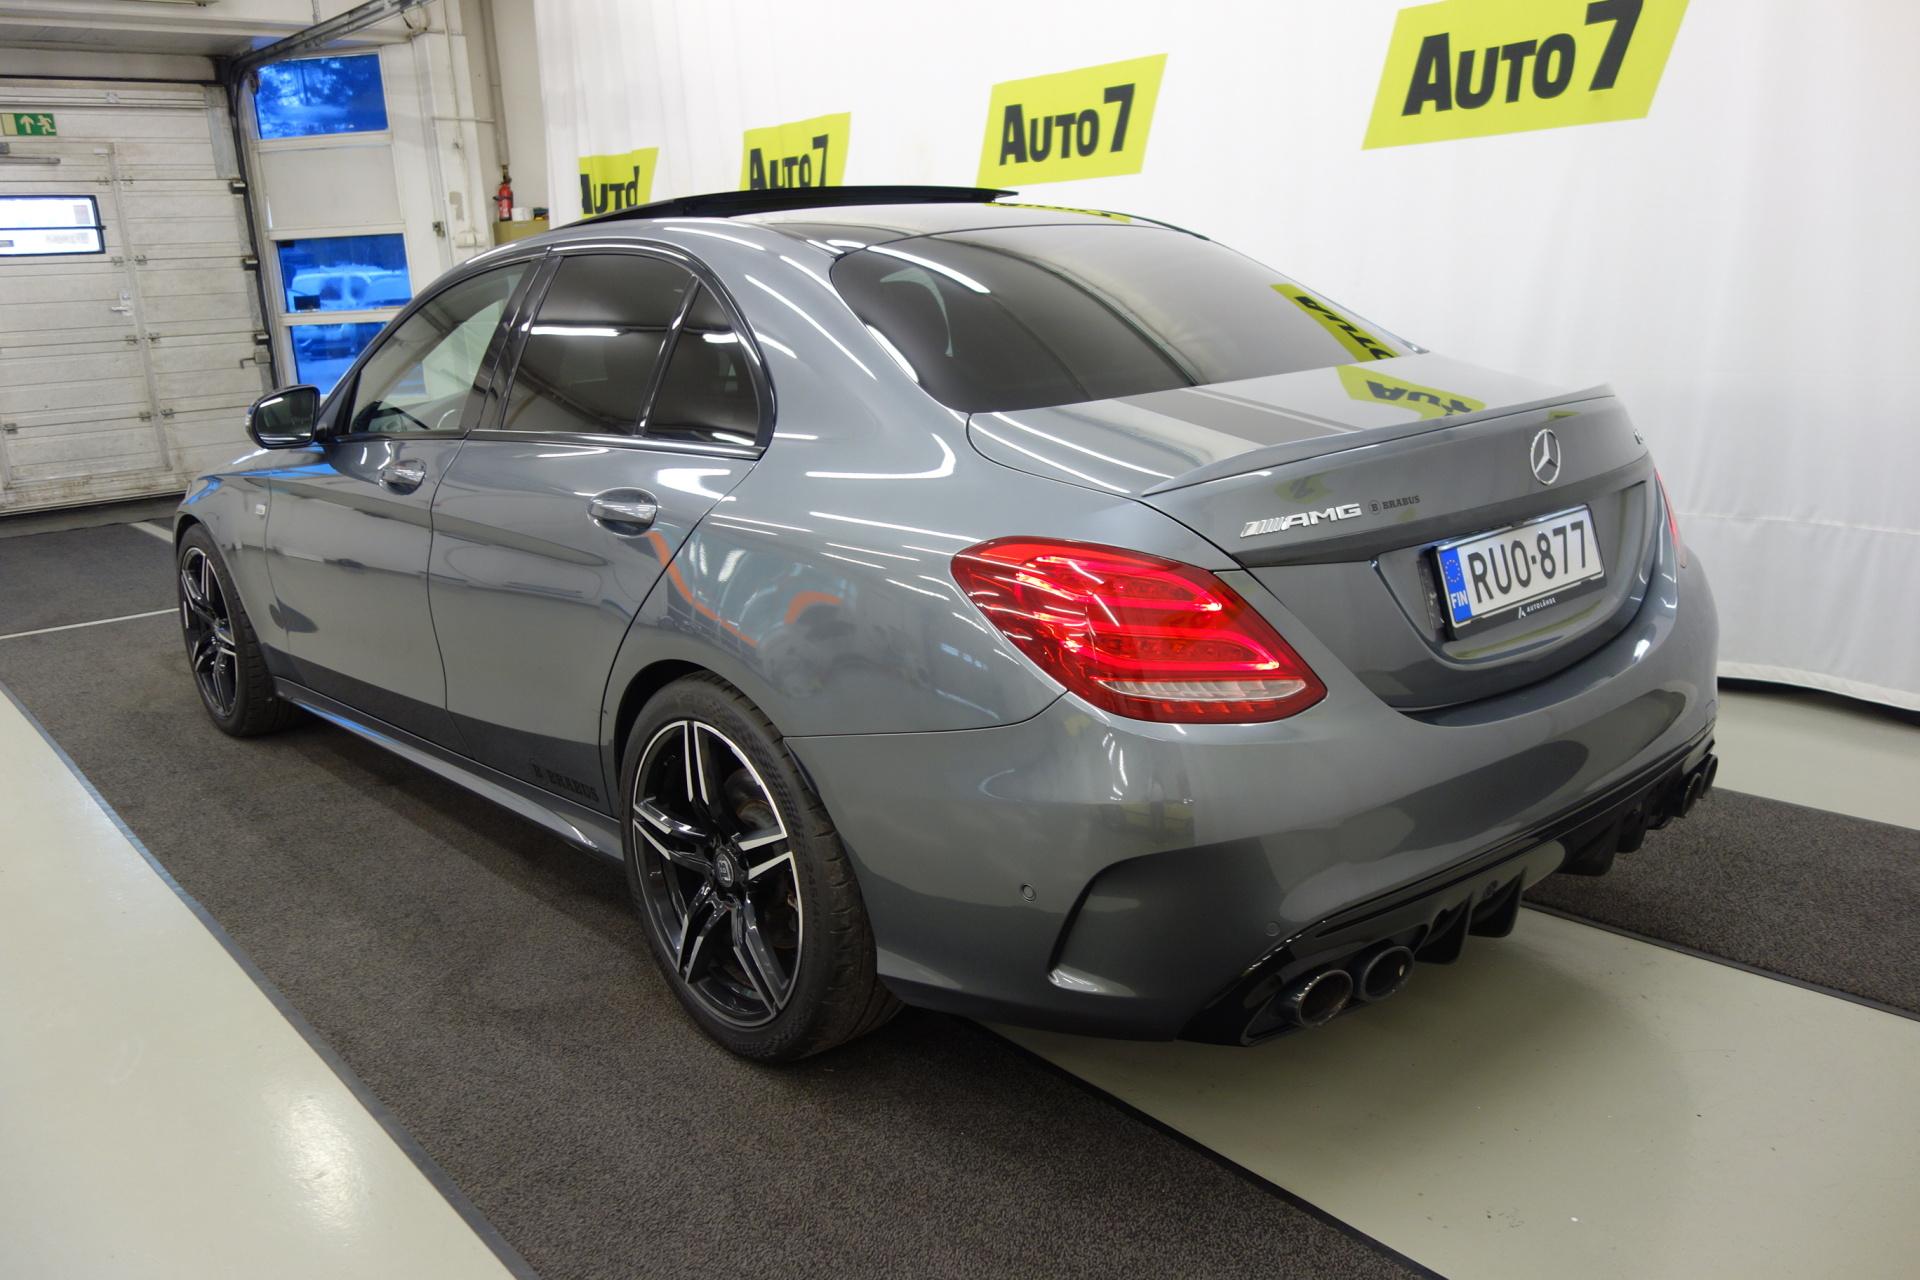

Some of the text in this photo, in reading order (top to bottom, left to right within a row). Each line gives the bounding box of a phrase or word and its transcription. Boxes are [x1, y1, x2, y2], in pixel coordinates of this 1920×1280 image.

[1382, 495, 1421, 511] BRABUS
[1467, 519, 1586, 604] RUO-877
[1450, 590, 1470, 609] FIN
